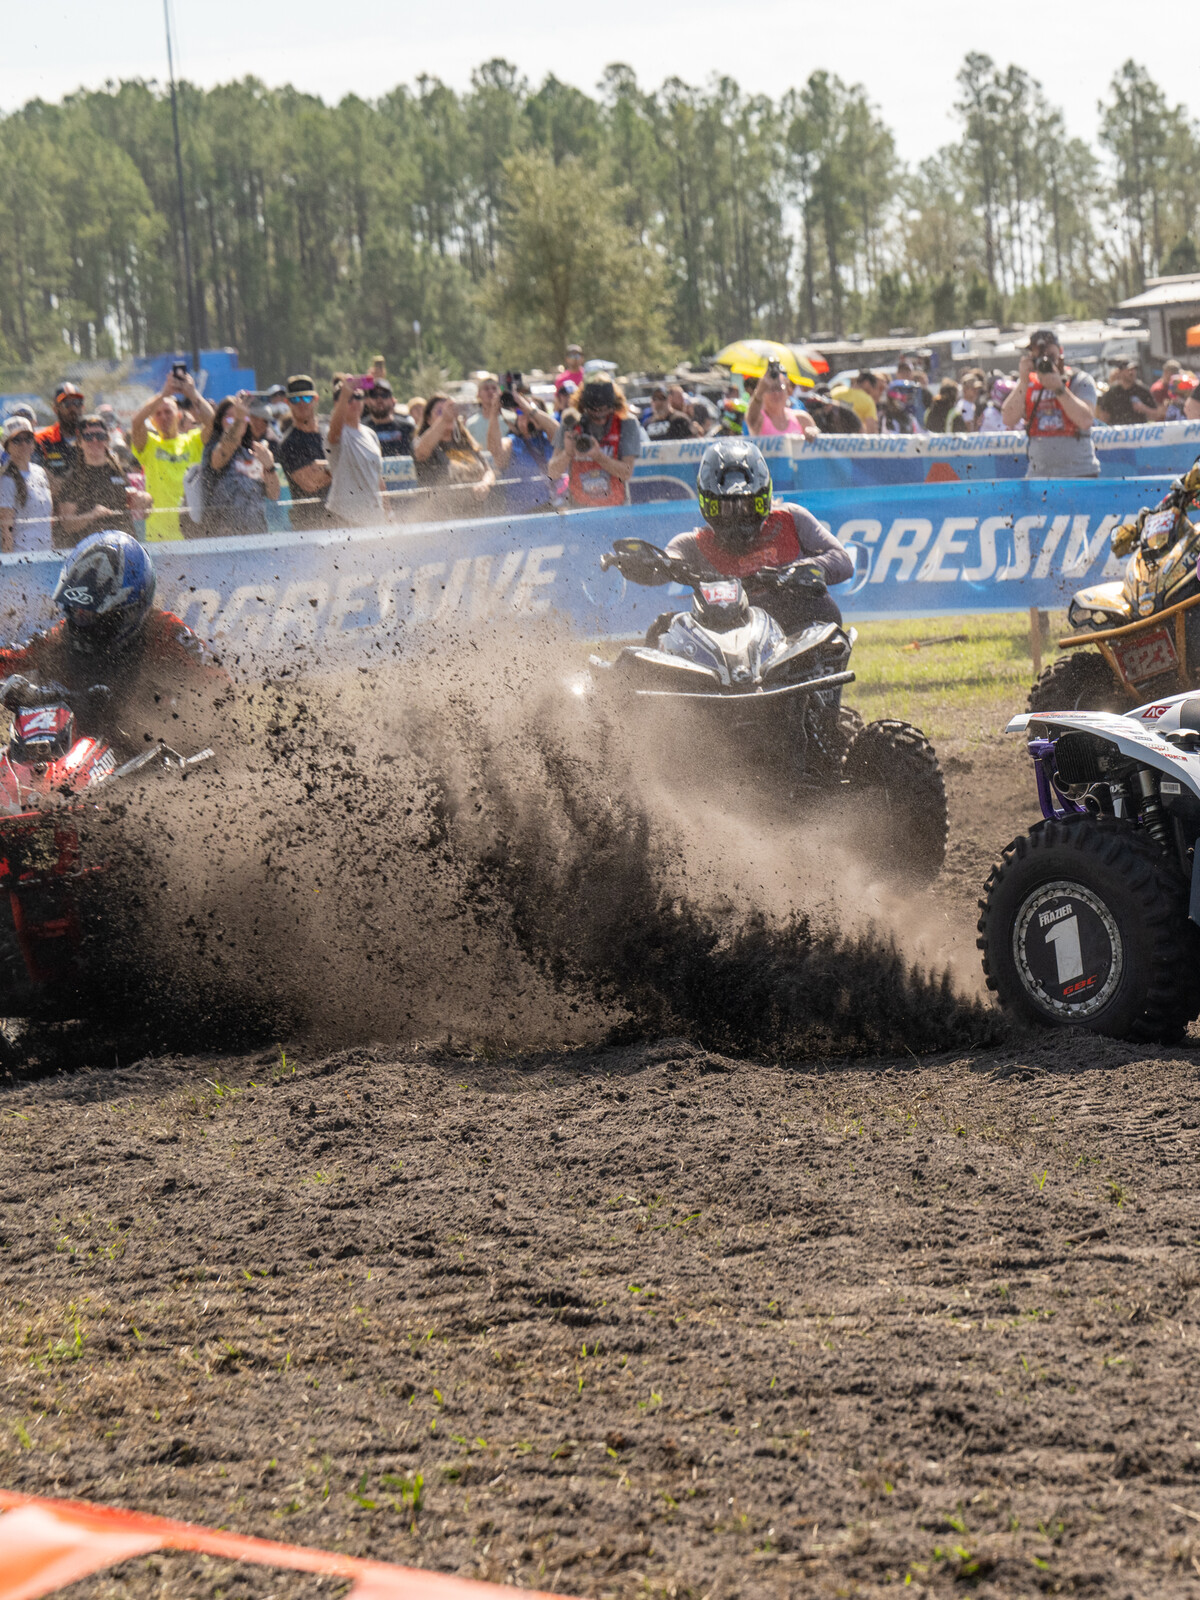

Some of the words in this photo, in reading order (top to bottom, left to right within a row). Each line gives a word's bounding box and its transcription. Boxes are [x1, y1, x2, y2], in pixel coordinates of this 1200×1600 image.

[800, 437, 908, 452] PROGRESSIVE
[927, 433, 1031, 451] PROGRESSIV
[1039, 903, 1073, 928] FRAZIER
[1044, 914, 1084, 985] 1
[1063, 974, 1098, 996] GBC
